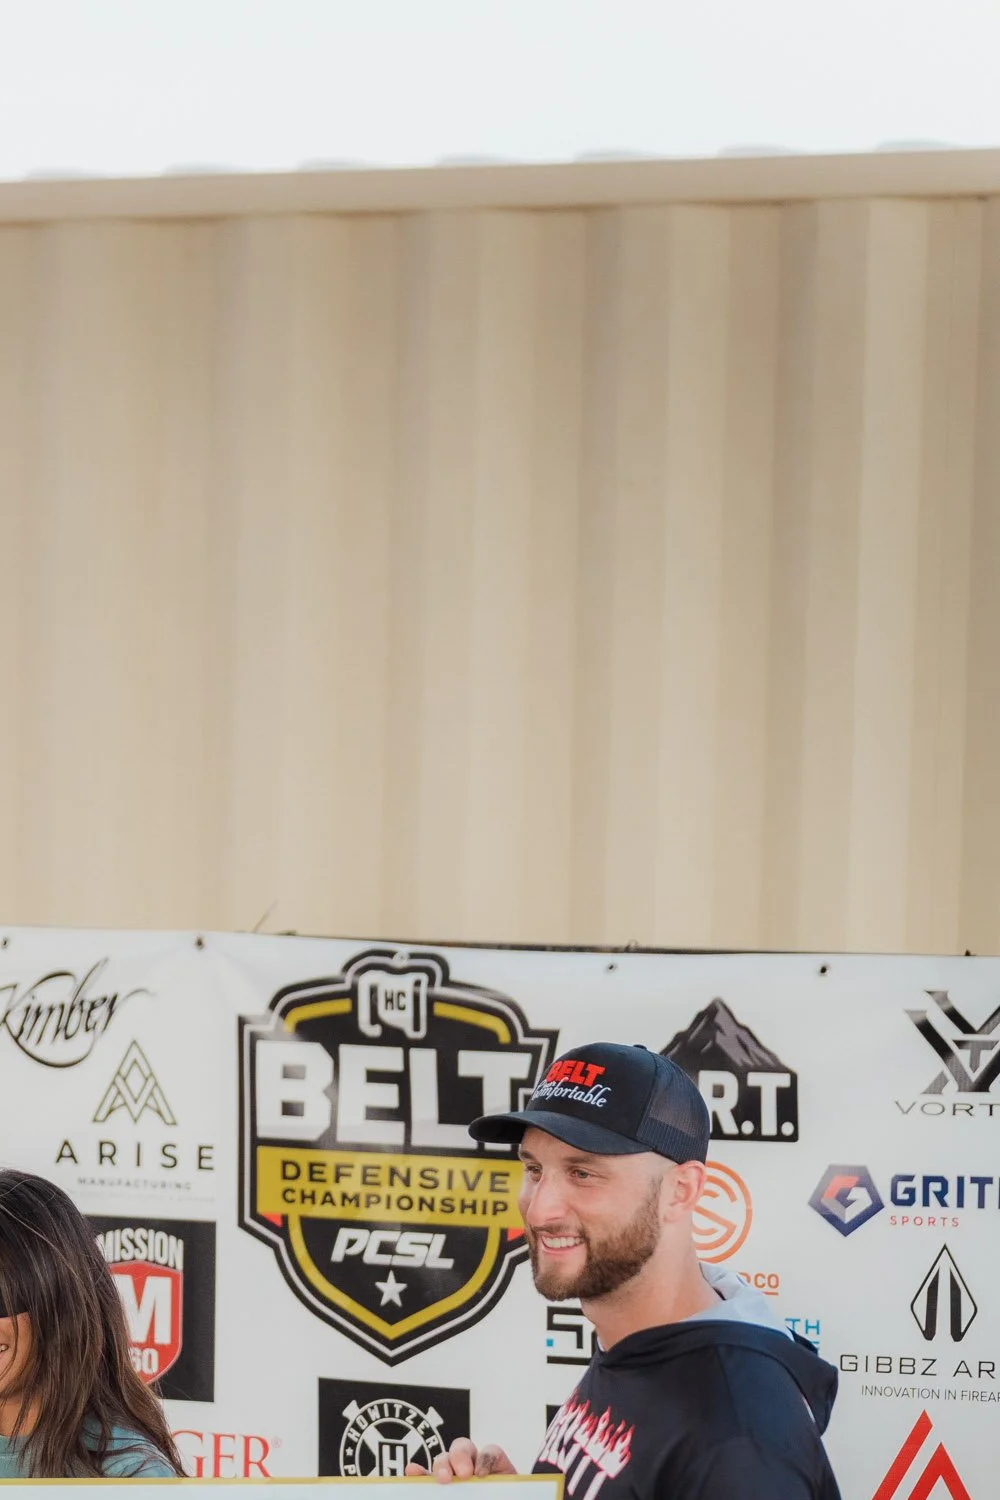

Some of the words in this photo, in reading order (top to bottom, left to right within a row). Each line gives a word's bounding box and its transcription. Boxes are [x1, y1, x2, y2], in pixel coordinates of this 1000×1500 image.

[384, 990, 407, 1012] HC
[545, 1059, 605, 1088] BELT
[256, 1040, 532, 1151] BELT
[55, 1138, 214, 1171] ARISE
[77, 1176, 192, 1190] MANUFACTURING
[280, 1160, 511, 1193] DEFENSIVE
[891, 1174, 1000, 1209] GRIT
[281, 1187, 509, 1216] CHAMPIONSHIP
[889, 1216, 959, 1227] SPORTS
[96, 1227, 184, 1271] MISSION
[331, 1227, 454, 1269] PCSL
[839, 1354, 938, 1376] GIBBZ
[861, 1385, 940, 1400] INNOVATION
[944, 1390, 957, 1400] IN
[347, 1403, 440, 1449] HOWITZER
